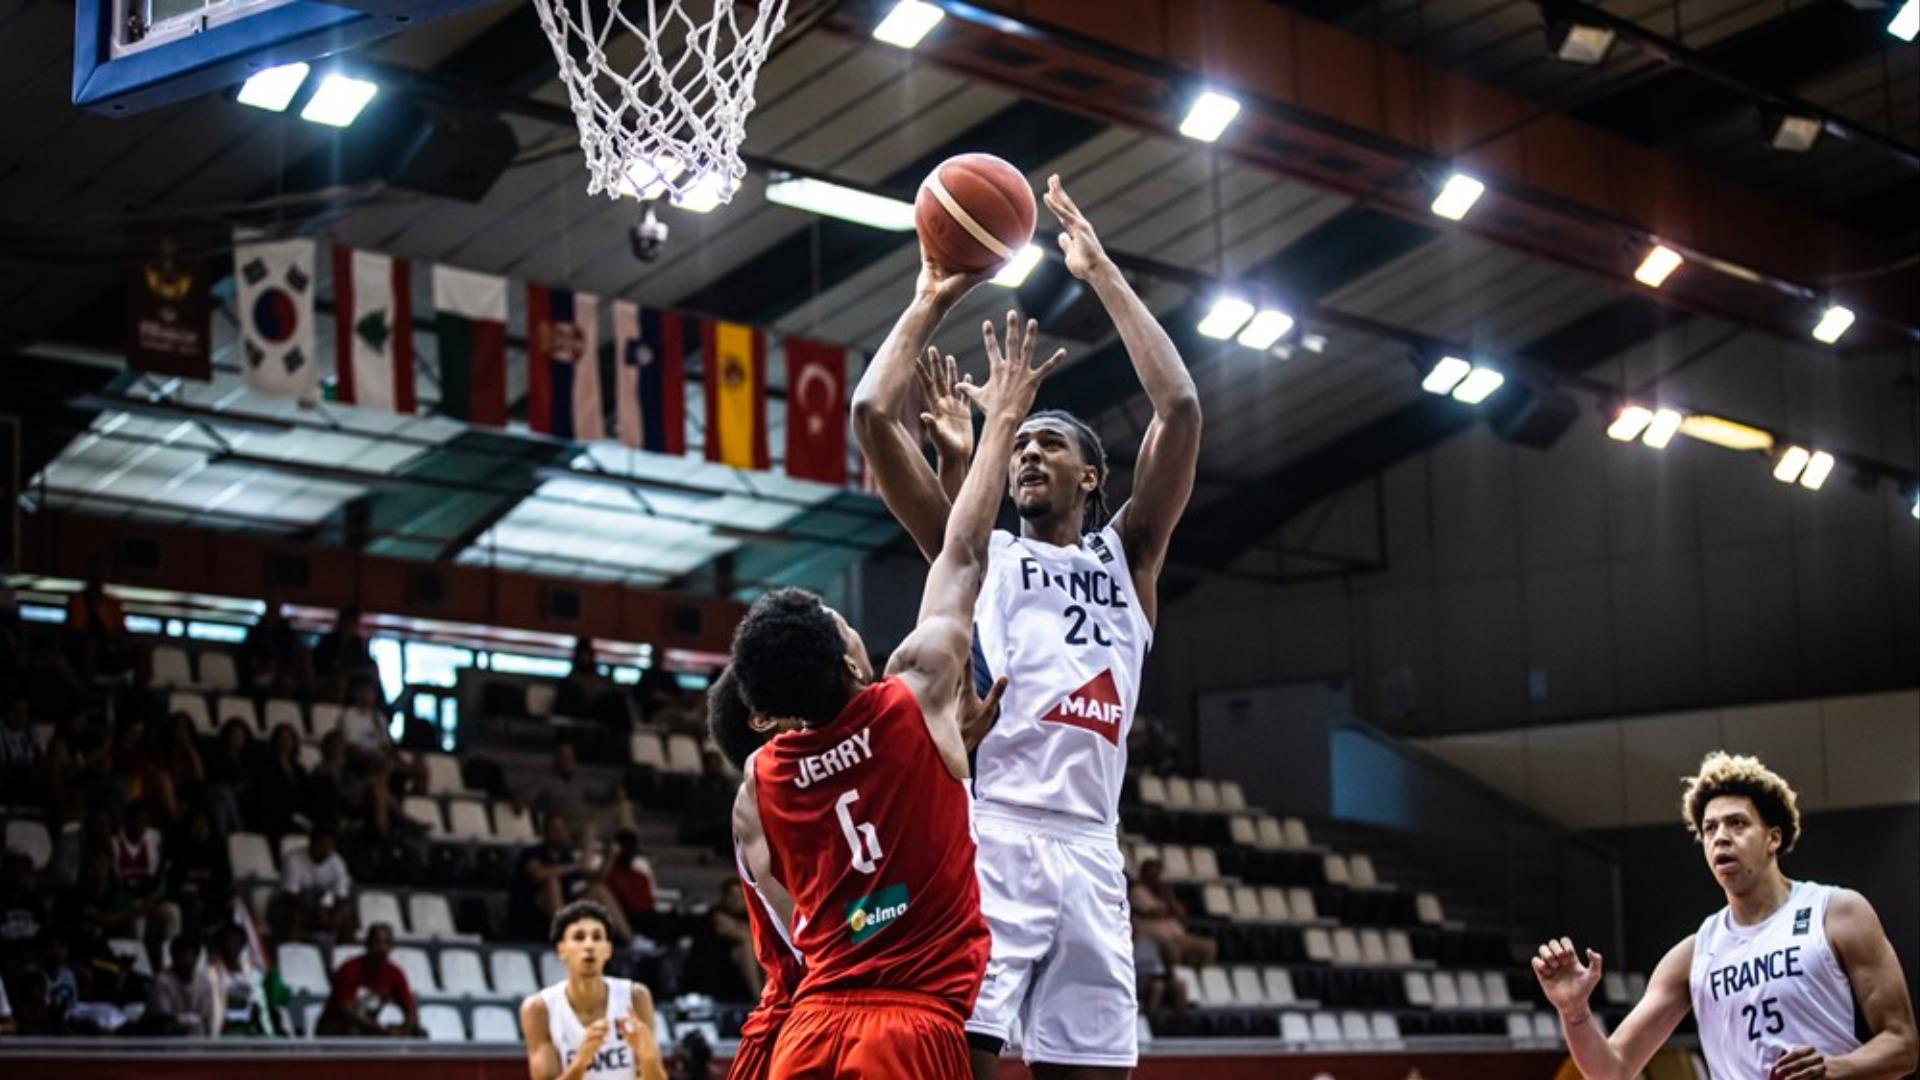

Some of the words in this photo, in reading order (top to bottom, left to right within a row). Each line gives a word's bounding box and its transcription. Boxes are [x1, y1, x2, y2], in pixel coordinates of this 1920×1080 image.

[1020, 557, 1128, 608] FNCE
[1060, 696, 1123, 725] MAIF
[793, 728, 873, 788] JERRY
[835, 789, 883, 874] 6
[1710, 946, 1802, 1001] FRANCE
[1742, 998, 1784, 1041] 25
